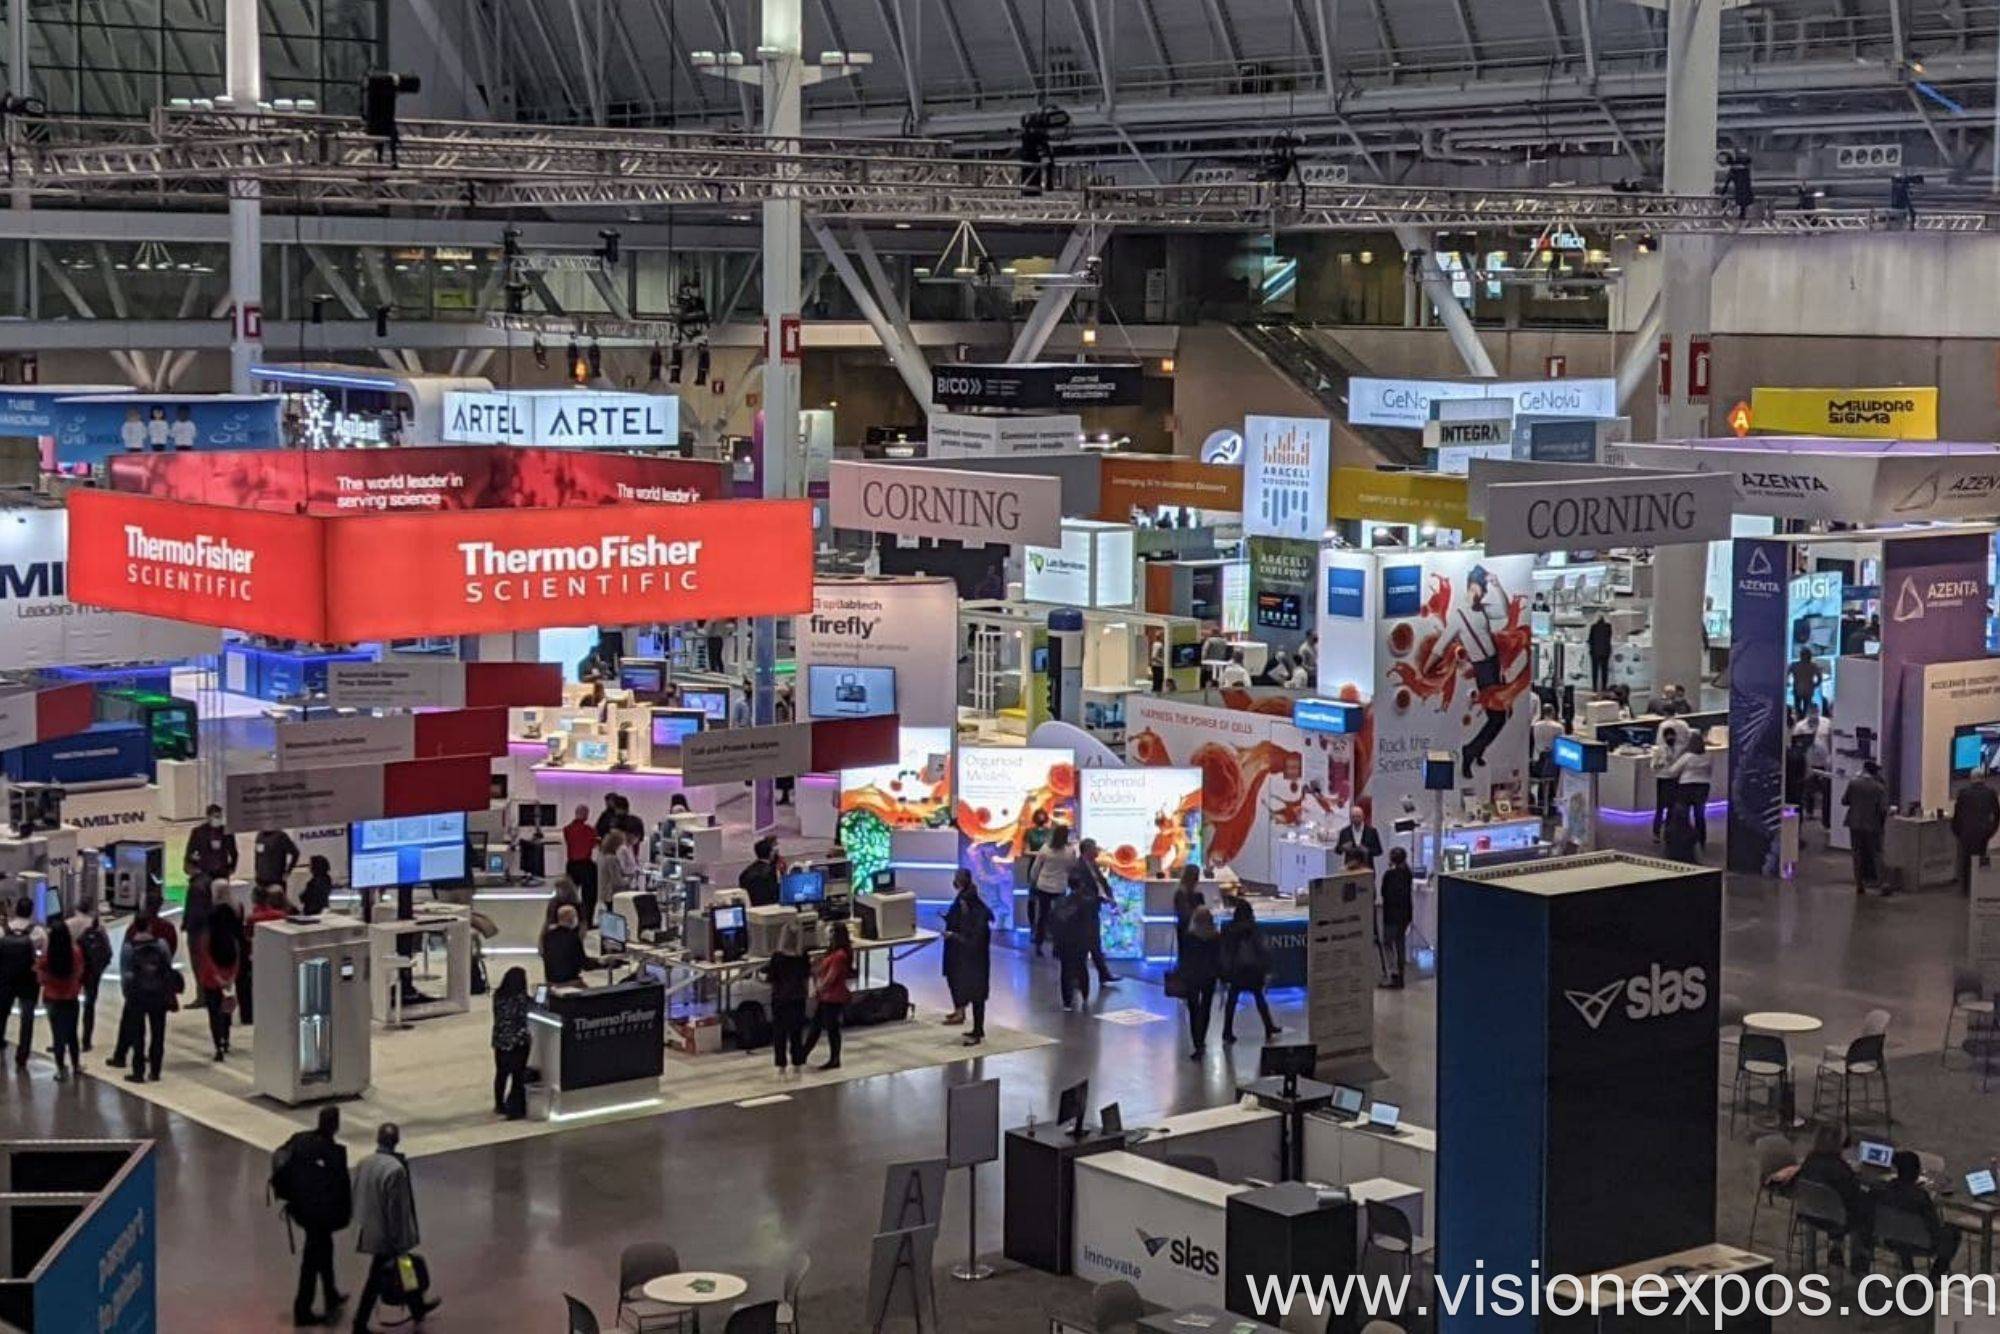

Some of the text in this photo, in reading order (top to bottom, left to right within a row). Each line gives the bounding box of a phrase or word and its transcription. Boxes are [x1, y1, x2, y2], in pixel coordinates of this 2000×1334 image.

[937, 377, 969, 395] BICO
[333, 412, 380, 441] Agilent
[452, 404, 525, 436] ARTEL
[548, 405, 664, 436] ARTEL
[1440, 423, 1501, 443] INTEGRA
[336, 472, 464, 491] The world leader in
[1262, 466, 1311, 479] ARACELI
[1742, 471, 1829, 493] AZENTA
[336, 490, 442, 510] serving science
[616, 482, 635, 499] The
[636, 485, 661, 501] world
[662, 487, 690, 503] leader
[863, 480, 1021, 533] CORNING
[1527, 490, 1696, 539] CORNING
[127, 564, 252, 602] SCIENTIFIC
[465, 569, 700, 605] SCIENTIFIC
[1739, 578, 1781, 595] AZENTA
[1927, 580, 1980, 599] AZENTA
[810, 614, 875, 640] firefly
[1089, 773, 1146, 791] Spheroid
[64, 811, 146, 828] AMILTON
[1625, 962, 1708, 1020] slas
[1083, 1244, 1143, 1281] Innovate
[1168, 1234, 1221, 1276] slas
